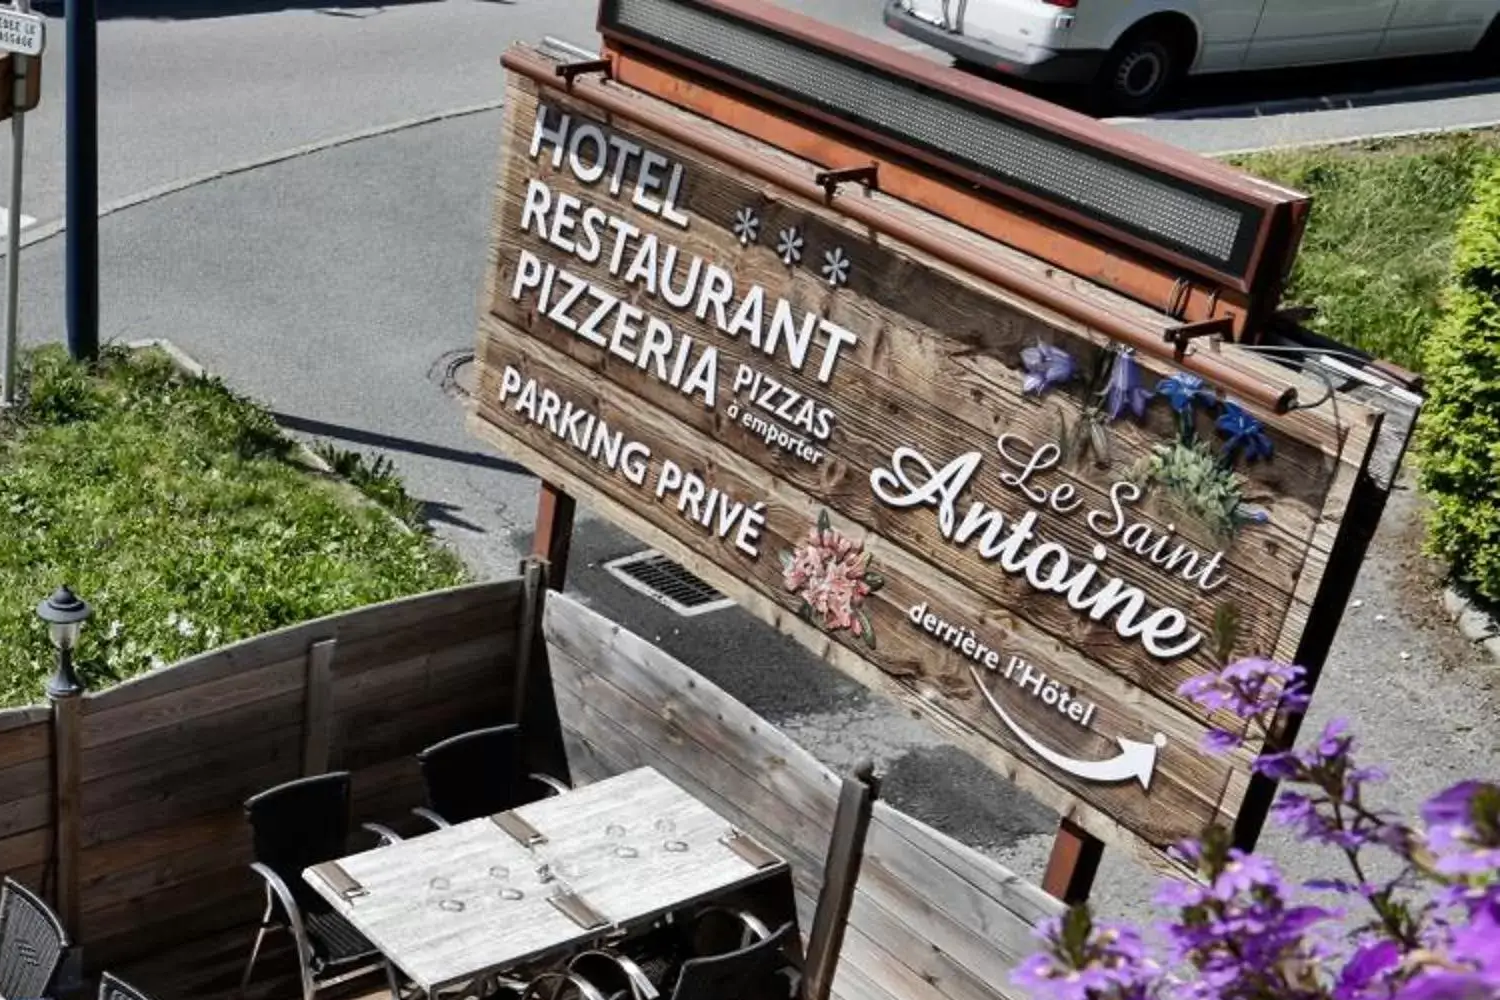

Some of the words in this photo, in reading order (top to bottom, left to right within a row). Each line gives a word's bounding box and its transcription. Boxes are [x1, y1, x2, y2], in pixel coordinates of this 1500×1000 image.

[25, 23, 36, 35] LE
[530, 105, 689, 228] HOTEL
[512, 250, 719, 407] PIZZERIA
[521, 179, 857, 383] RESTAURANT
[500, 366, 652, 484] PARKING
[655, 458, 767, 558] PRIVÉ
[733, 363, 835, 440] PIZZAS
[742, 411, 824, 464] emporter
[870, 446, 1202, 659] Antoine
[998, 434, 1084, 512] Le
[1088, 481, 1231, 592] Saint
[908, 601, 1000, 670] derrière
[1003, 655, 1096, 726] l'Hôtel
